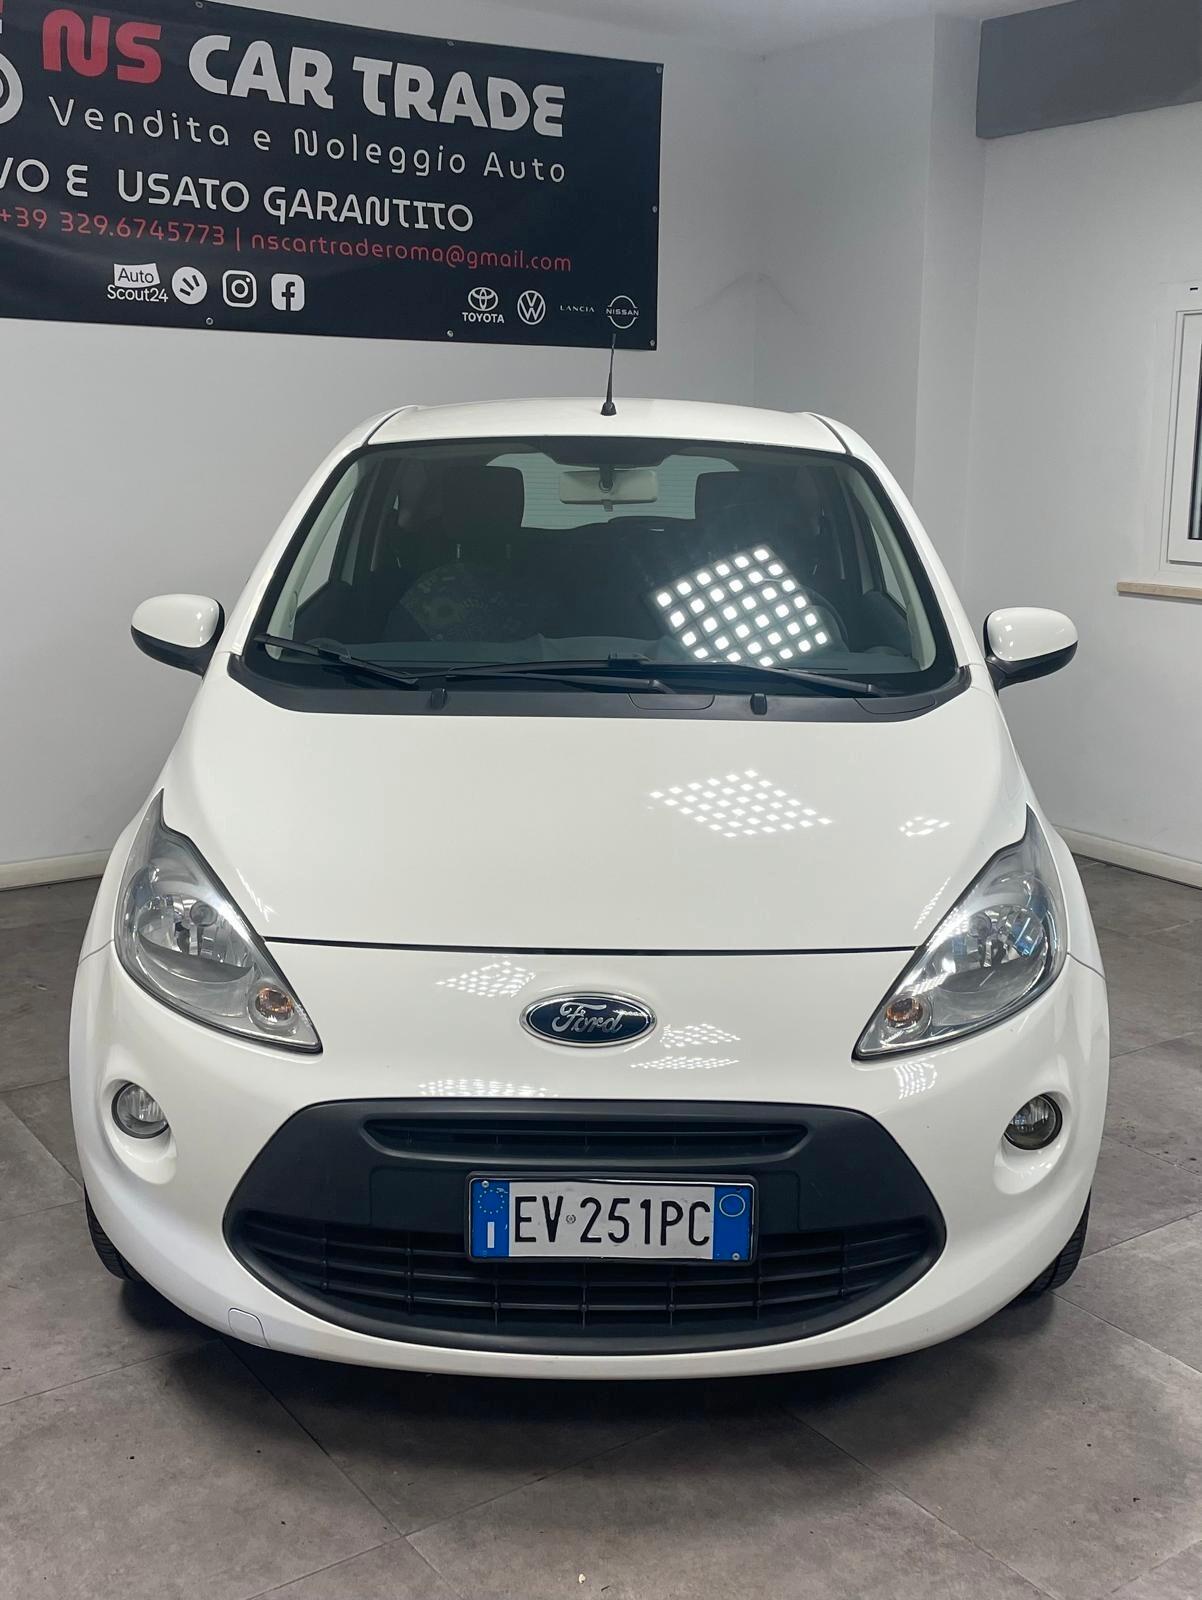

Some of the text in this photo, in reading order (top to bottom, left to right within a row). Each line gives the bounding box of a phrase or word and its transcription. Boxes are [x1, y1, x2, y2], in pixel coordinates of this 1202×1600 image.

[42, 9, 566, 138] NS CAR TRADE
[49, 96, 565, 183] Vendita e Noleggio Auto
[66, 164, 89, 197] E
[118, 169, 250, 213] USATO
[263, 186, 474, 232] GARANTITO
[0, 206, 47, 230] +39
[59, 211, 225, 246] 329.6745773
[251, 233, 572, 272] nscartraderoma@gmail.com
[117, 267, 155, 284] Auto
[107, 285, 169, 303] Scout24
[560, 304, 595, 313] LANCIA
[462, 312, 505, 324] TOYOTA
[605, 307, 640, 317] NISSAN
[551, 1001, 624, 1034] Ford
[514, 1195, 564, 1243] EV
